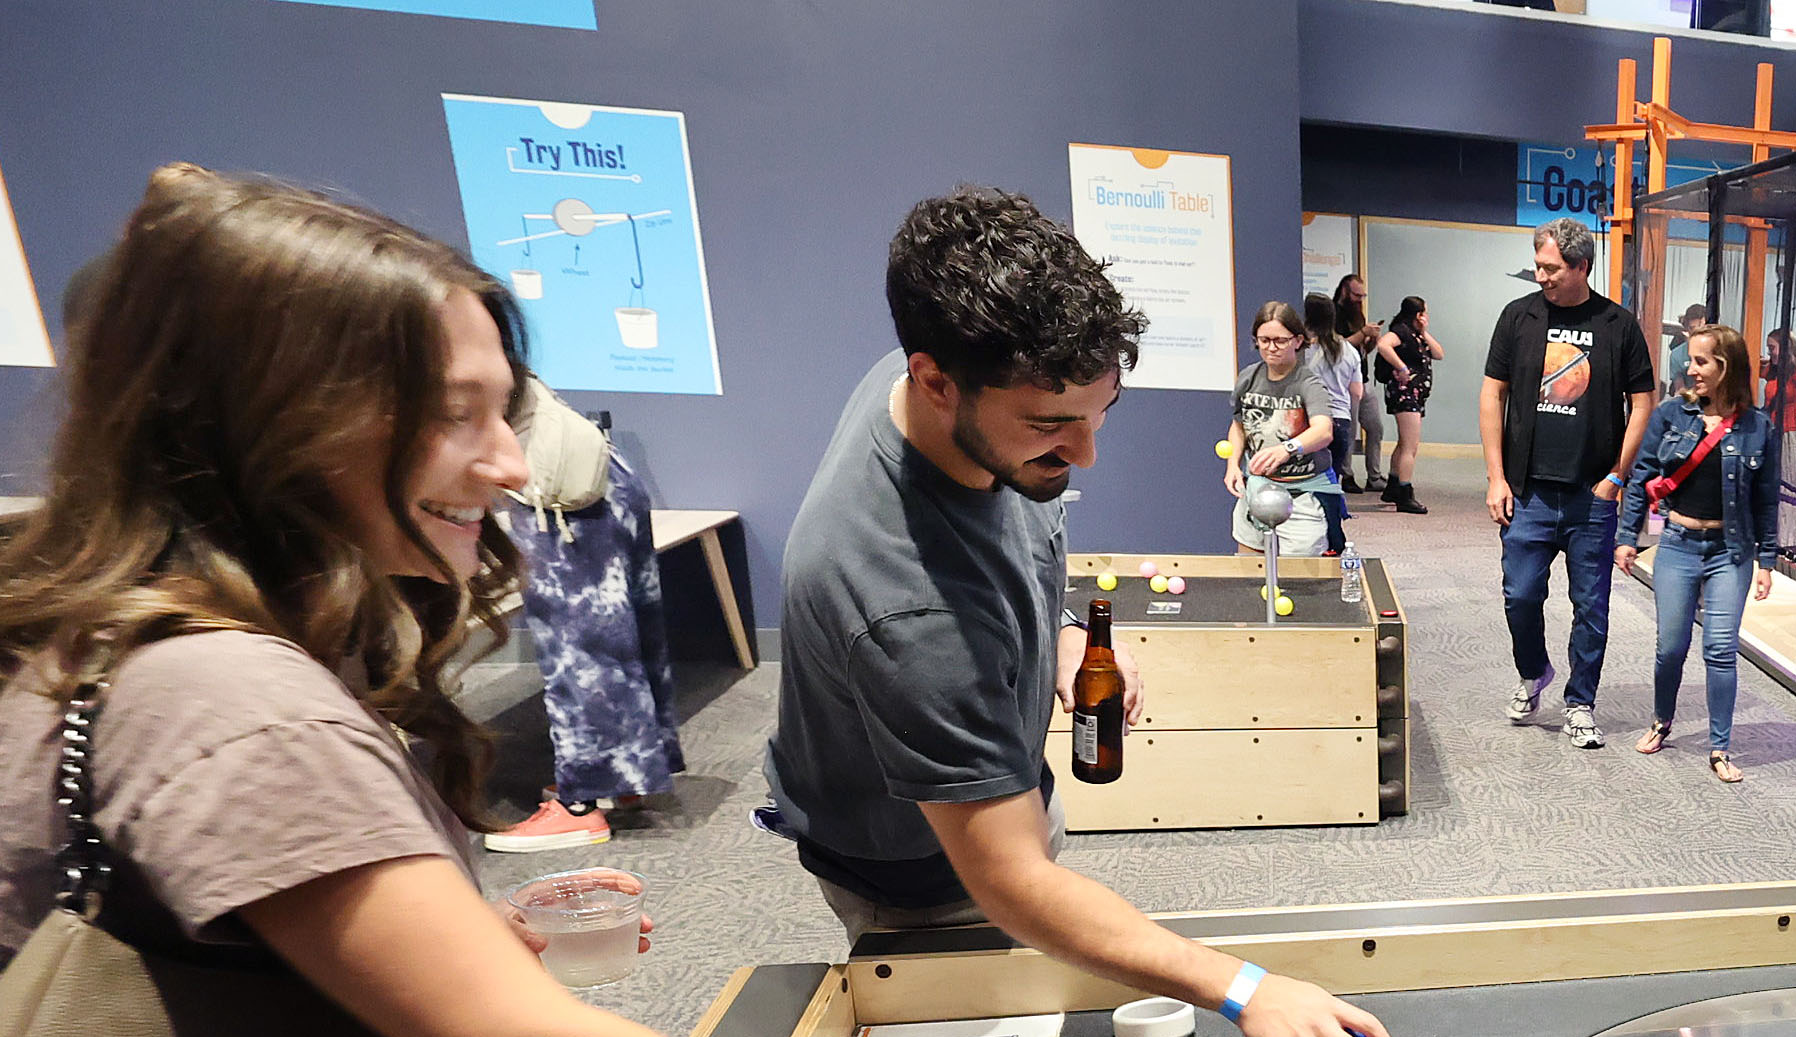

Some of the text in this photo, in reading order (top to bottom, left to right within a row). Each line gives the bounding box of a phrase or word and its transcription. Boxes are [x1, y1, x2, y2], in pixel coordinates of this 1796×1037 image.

[519, 137, 626, 171] Try This!
[1096, 186, 1209, 213] Bernoulli Table
[1536, 399, 1578, 416] cience
